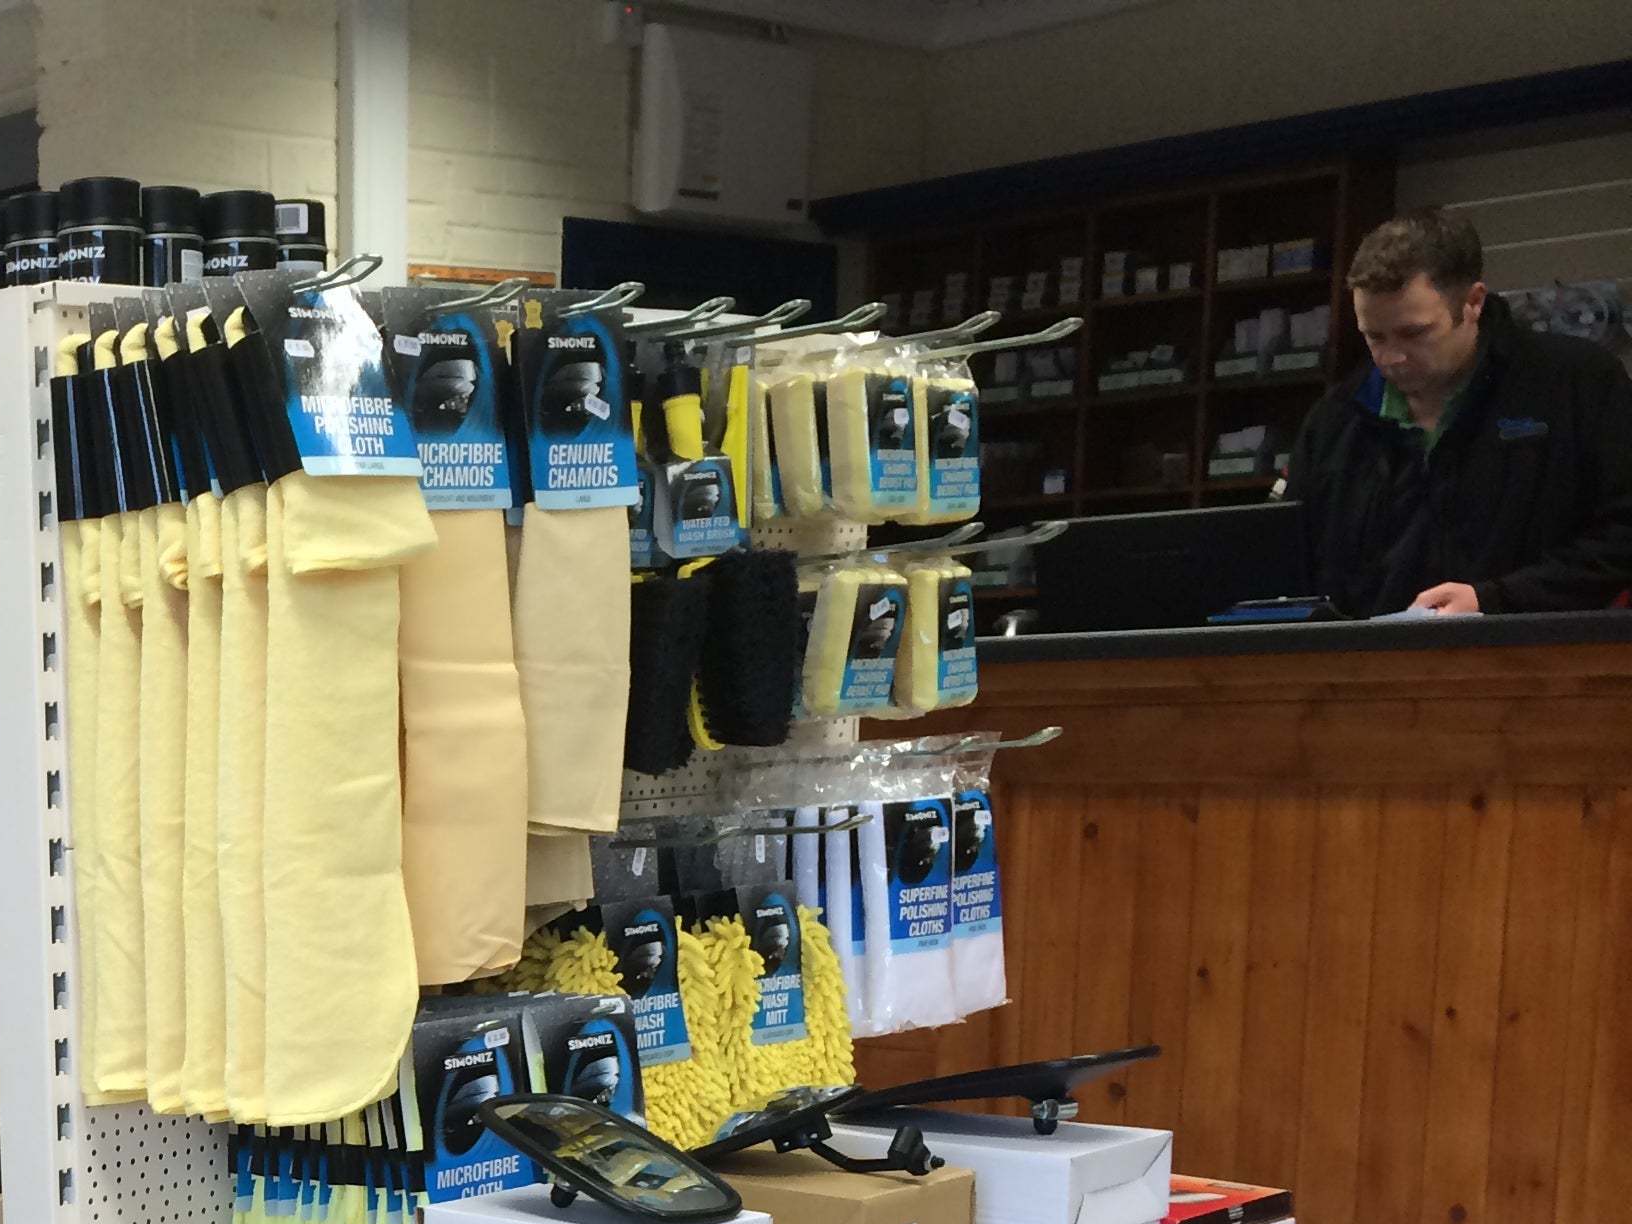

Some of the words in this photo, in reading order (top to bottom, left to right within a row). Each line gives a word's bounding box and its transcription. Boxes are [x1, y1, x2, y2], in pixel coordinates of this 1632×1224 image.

[418, 333, 467, 347] SIMONIZ
[548, 336, 596, 350] SIMONIZ
[548, 442, 614, 466] GENUINE
[423, 465, 494, 488] CHAMOIS
[548, 465, 618, 488] CHAMOIS
[568, 1033, 614, 1051] SIMONIZ
[444, 1051, 493, 1071] SIMONIZ
[437, 1154, 520, 1190] MICROFIBRE
